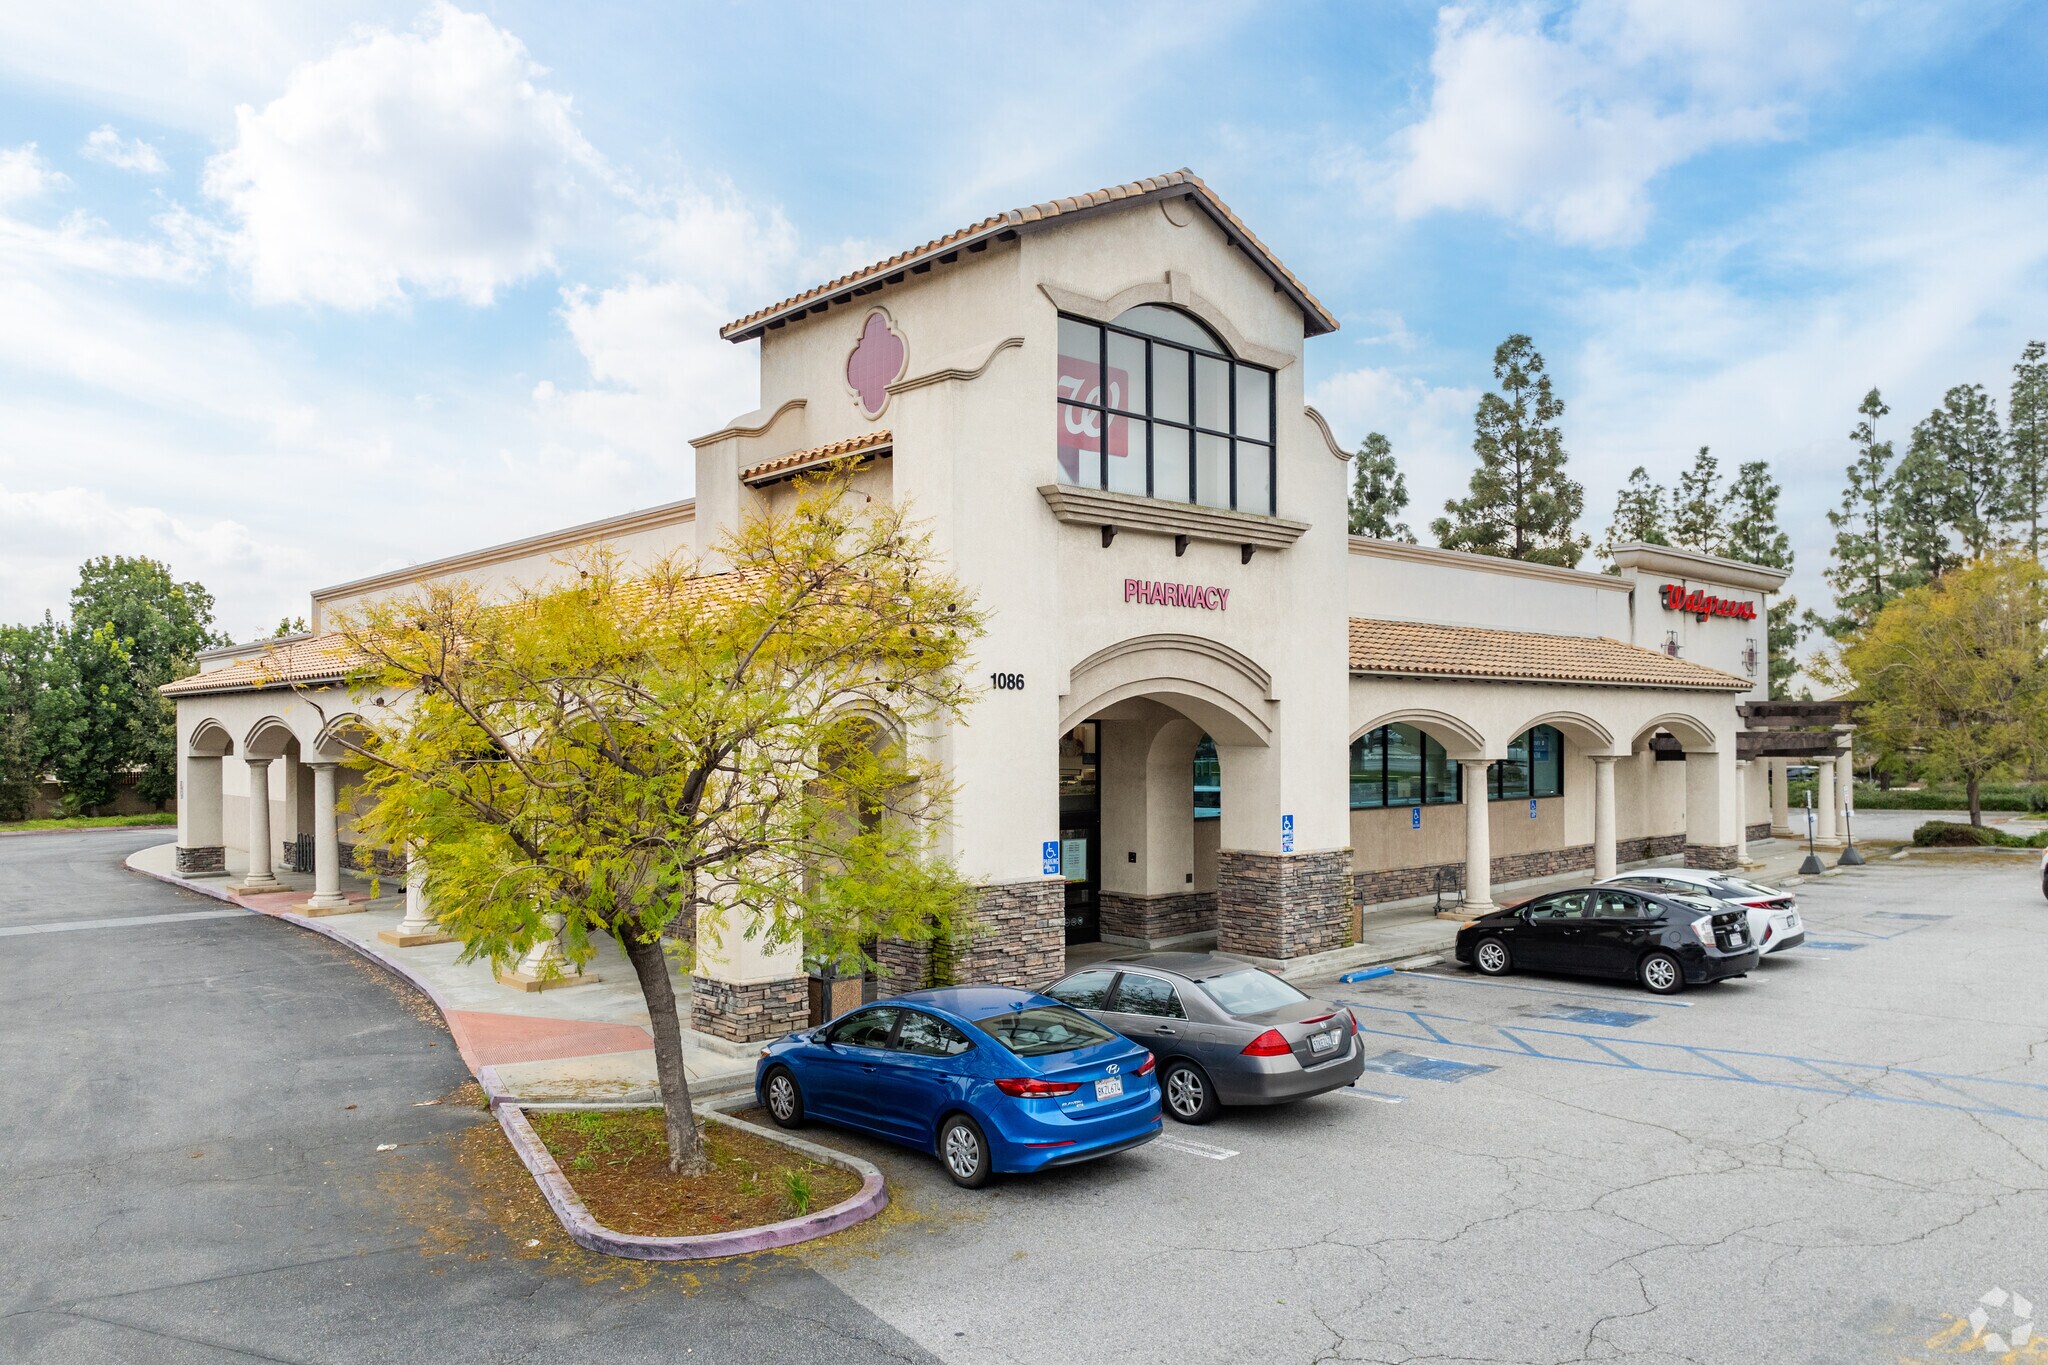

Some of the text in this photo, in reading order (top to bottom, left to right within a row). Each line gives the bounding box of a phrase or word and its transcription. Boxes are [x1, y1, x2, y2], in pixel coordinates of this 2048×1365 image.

[1124, 578, 1230, 611] PHARMACY
[1661, 584, 1757, 622] Walgreens
[990, 672, 1025, 691] 1086
